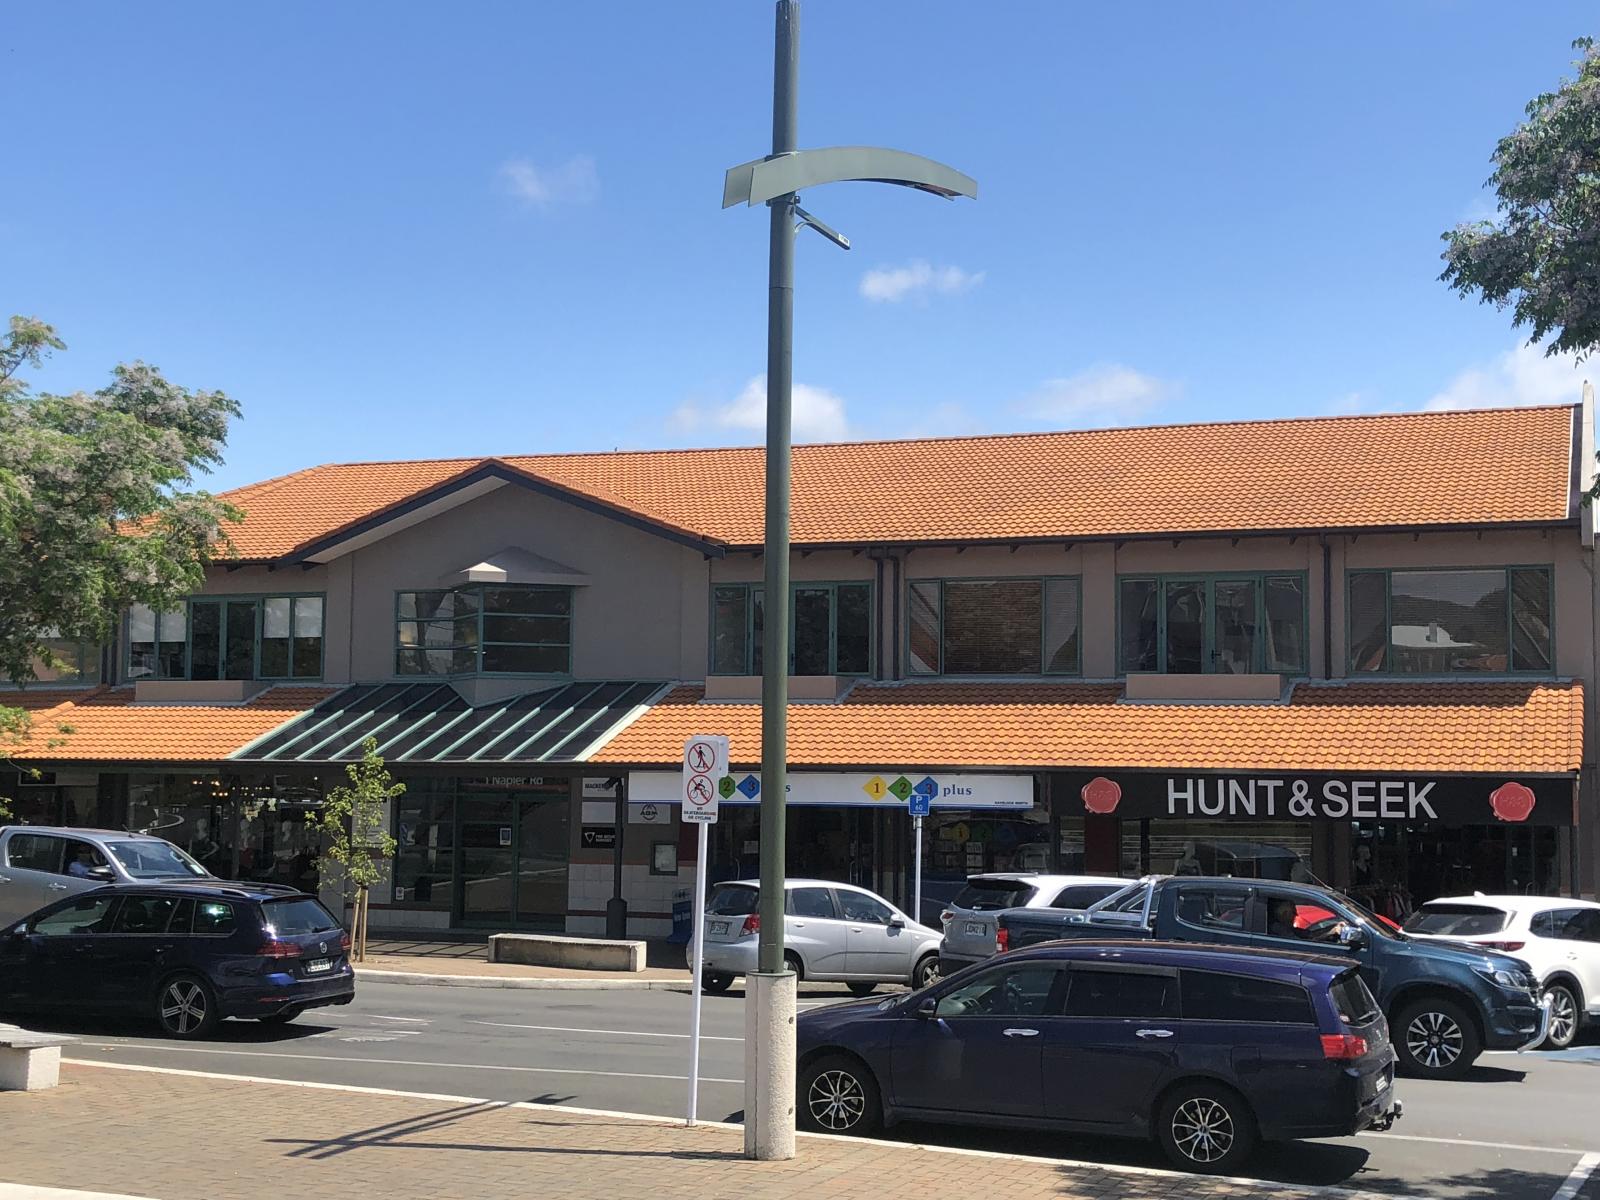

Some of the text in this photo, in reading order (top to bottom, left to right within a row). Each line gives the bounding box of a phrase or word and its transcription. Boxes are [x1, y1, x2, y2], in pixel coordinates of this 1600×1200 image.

[492, 777, 527, 789] Napier
[723, 781, 731, 792] 2
[748, 780, 756, 792] 3
[873, 782, 880, 793] 1
[899, 782, 907, 793] 2
[925, 783, 972, 797] 3 plus
[916, 795, 923, 804] P
